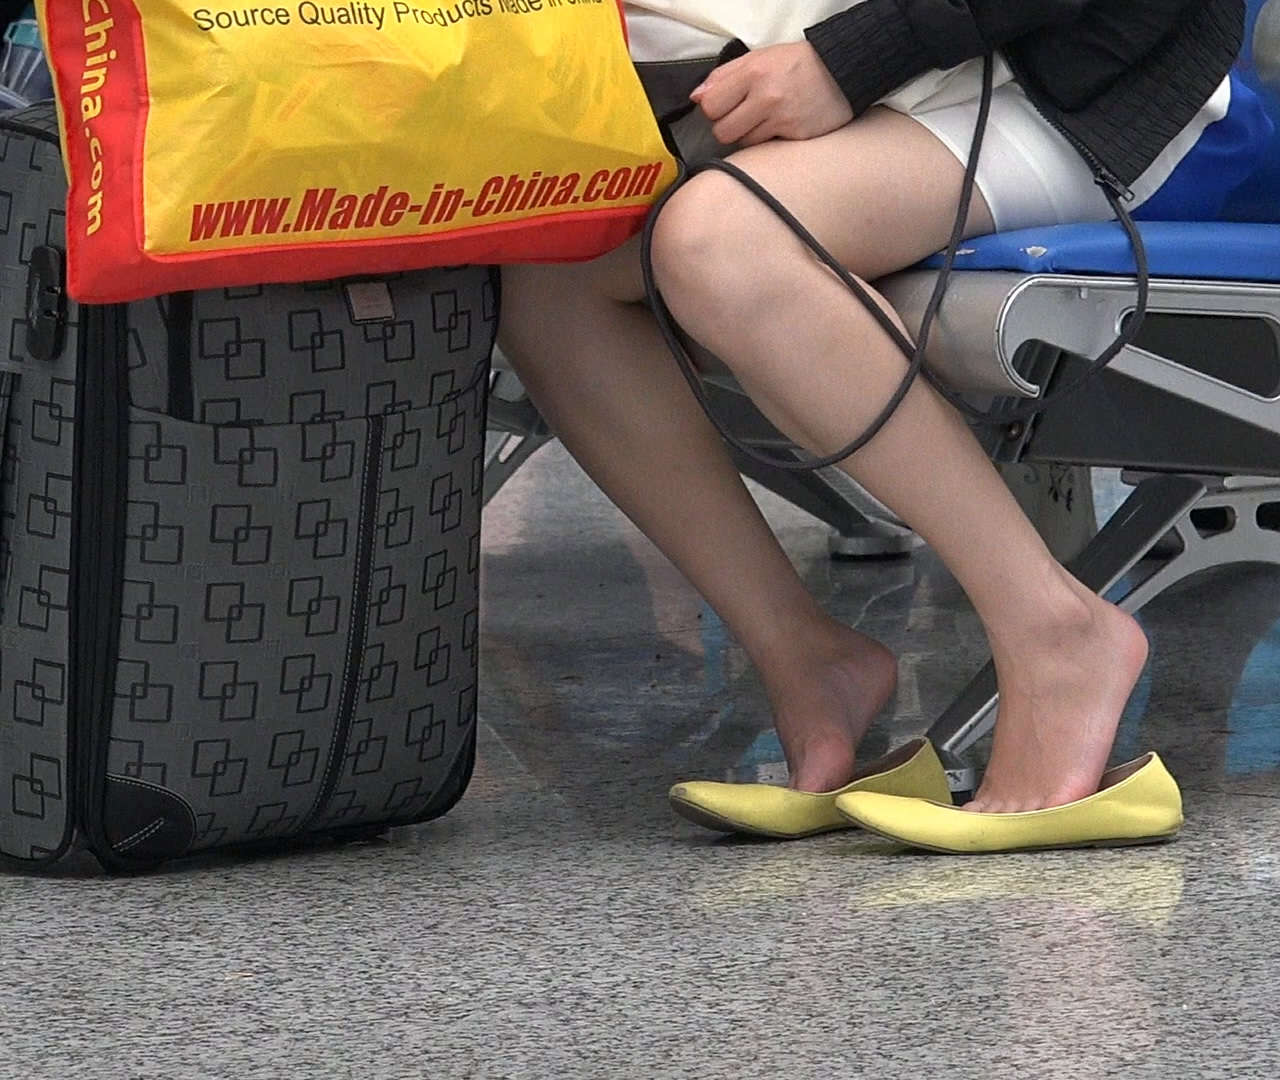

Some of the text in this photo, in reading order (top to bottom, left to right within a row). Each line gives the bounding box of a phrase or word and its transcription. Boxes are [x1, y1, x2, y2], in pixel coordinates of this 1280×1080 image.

[193, 7, 290, 31] Source
[298, 1, 386, 31] Quality
[190, 161, 663, 242] www.Made-in-China.com
